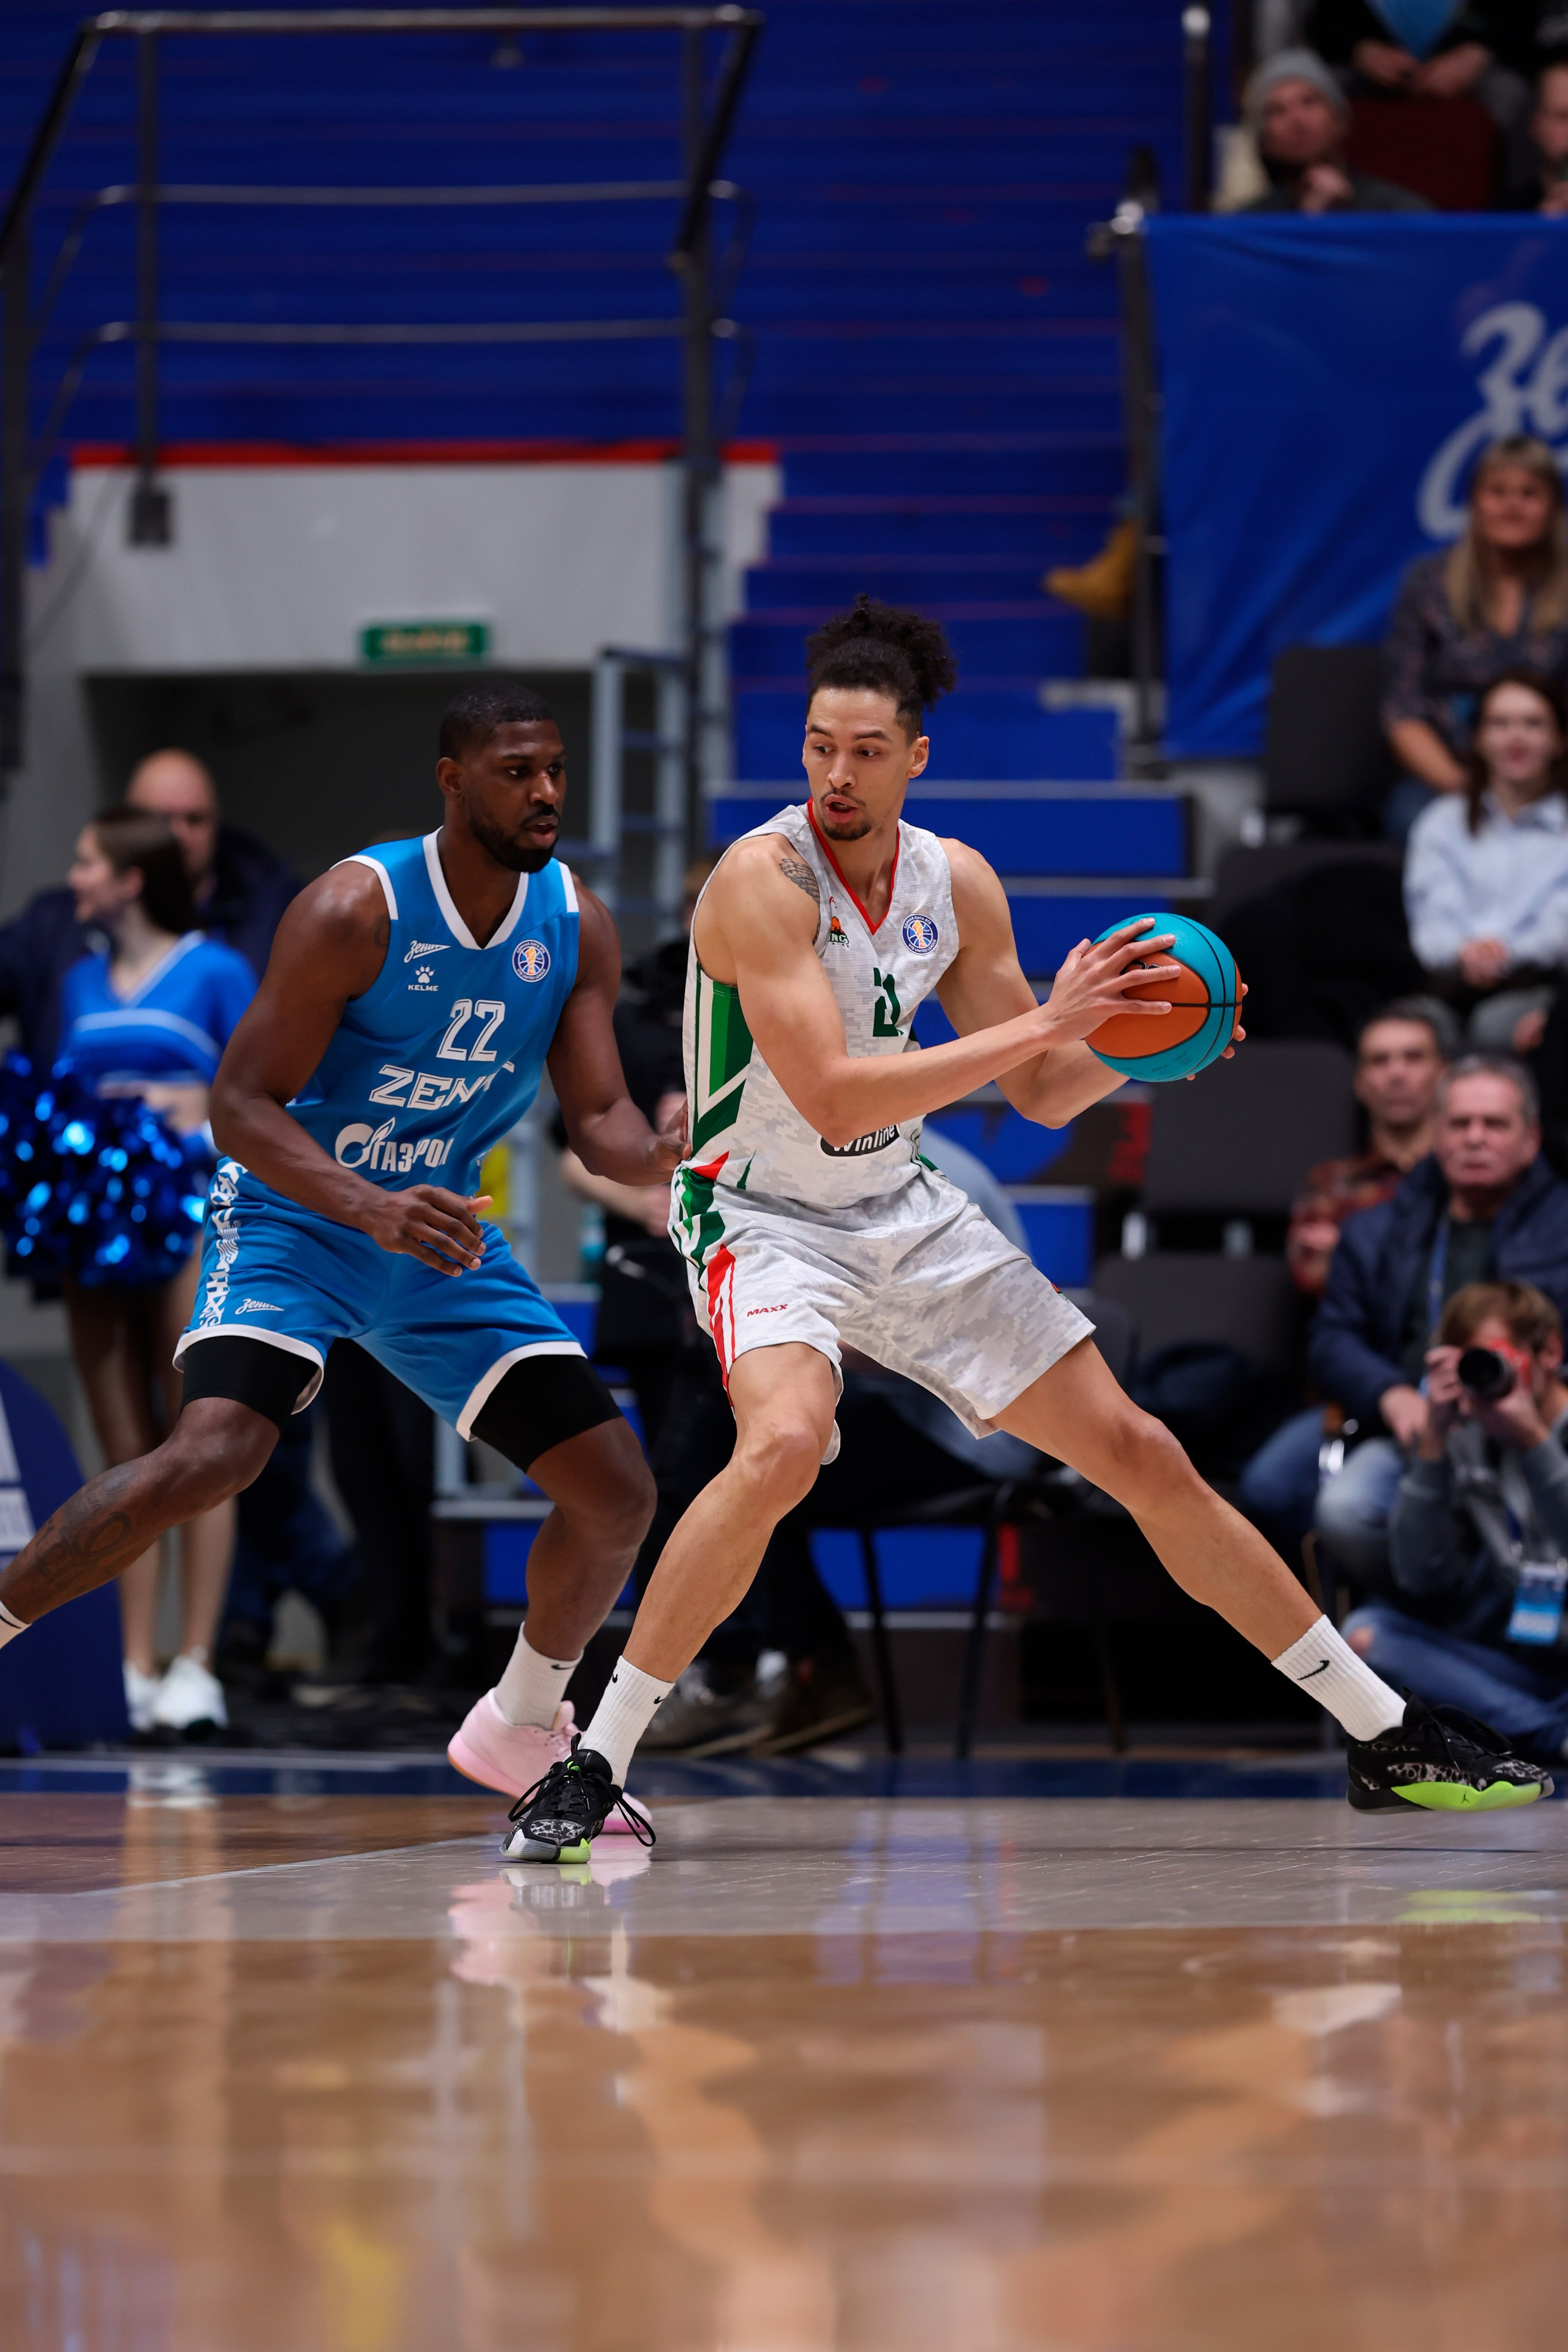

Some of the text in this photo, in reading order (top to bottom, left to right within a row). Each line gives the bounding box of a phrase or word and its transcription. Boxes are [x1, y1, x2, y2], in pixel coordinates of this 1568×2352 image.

[435, 998, 505, 1061] 22
[834, 1123, 895, 1152] inline
[747, 1304, 788, 1317] MAXX
